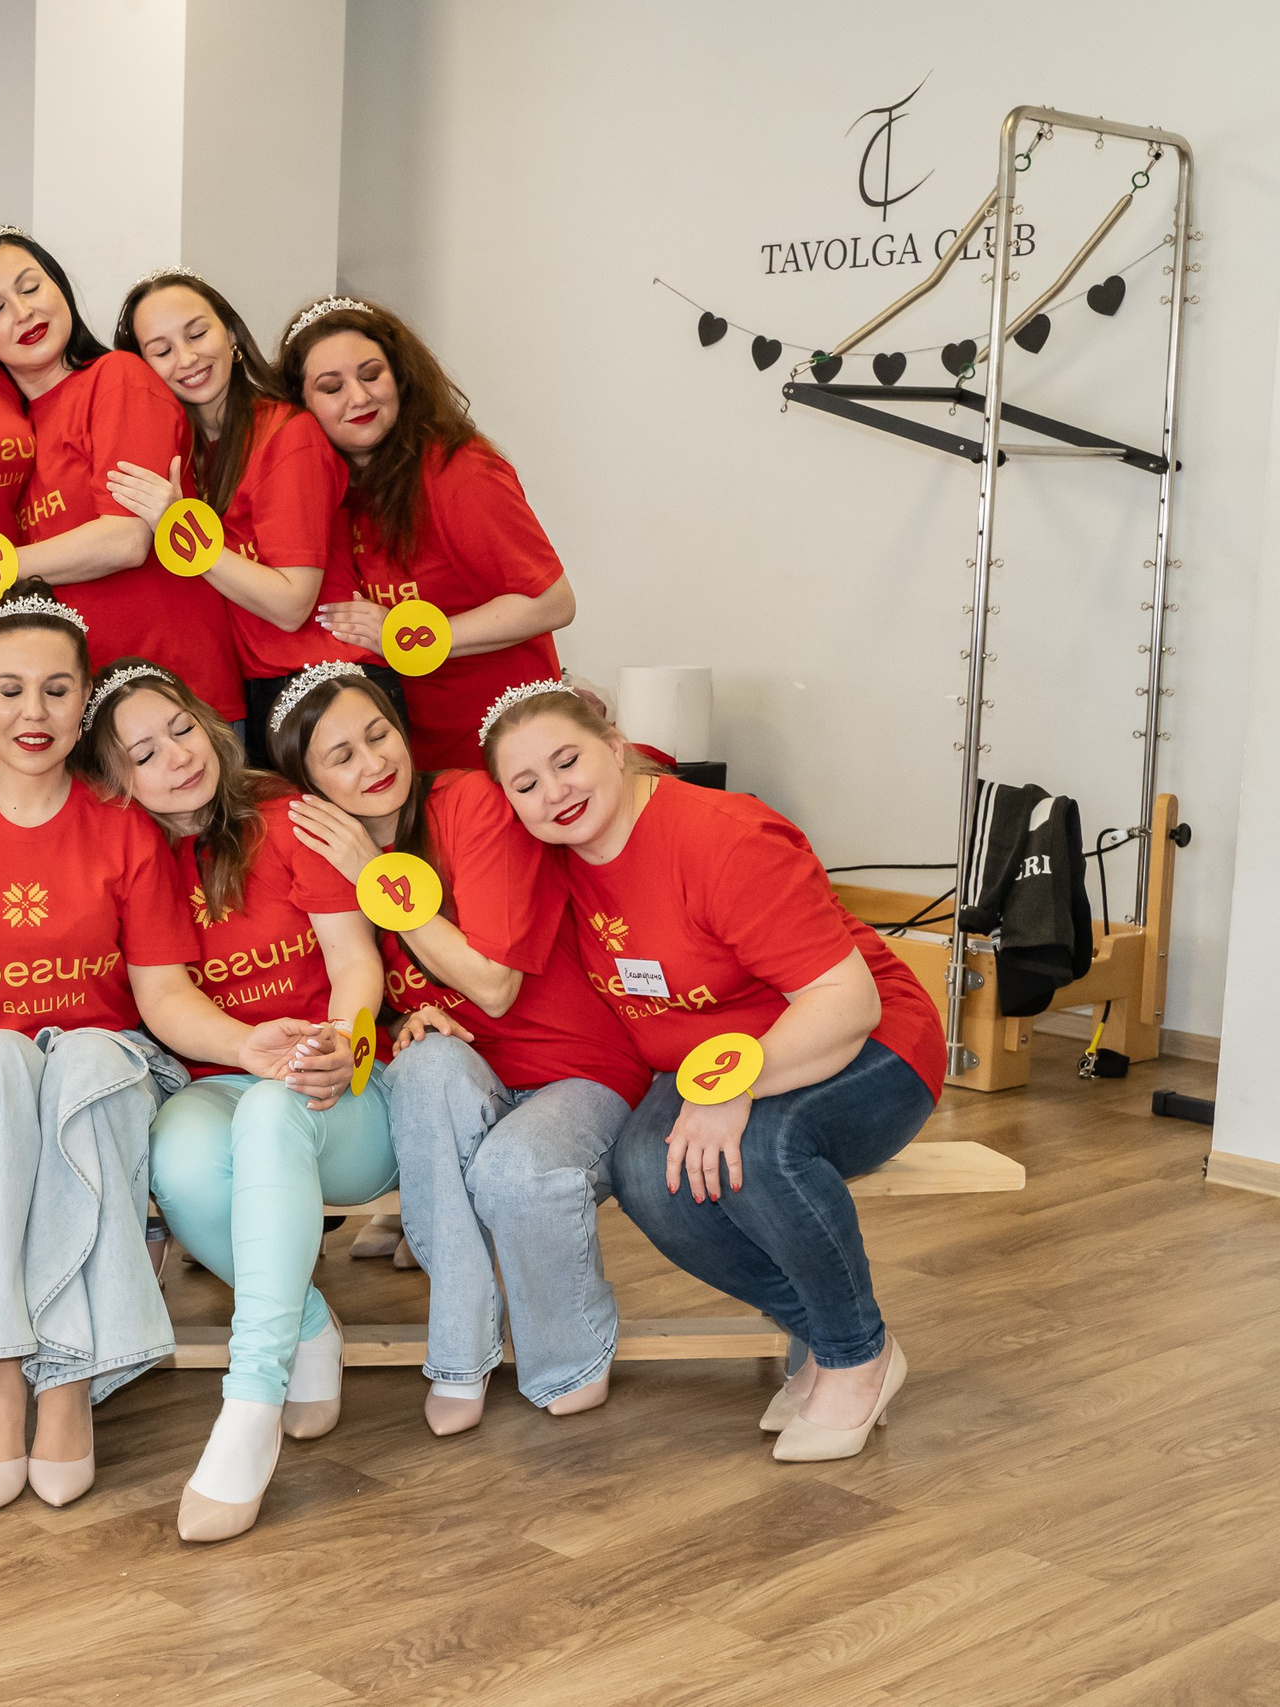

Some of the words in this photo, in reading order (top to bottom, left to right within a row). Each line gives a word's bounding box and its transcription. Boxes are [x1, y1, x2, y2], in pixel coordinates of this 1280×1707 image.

[761, 232, 922, 275] TAVOLGA
[170, 510, 213, 563] 10
[395, 626, 436, 651] 8
[377, 874, 415, 913] 4
[692, 1050, 742, 1091] 2
